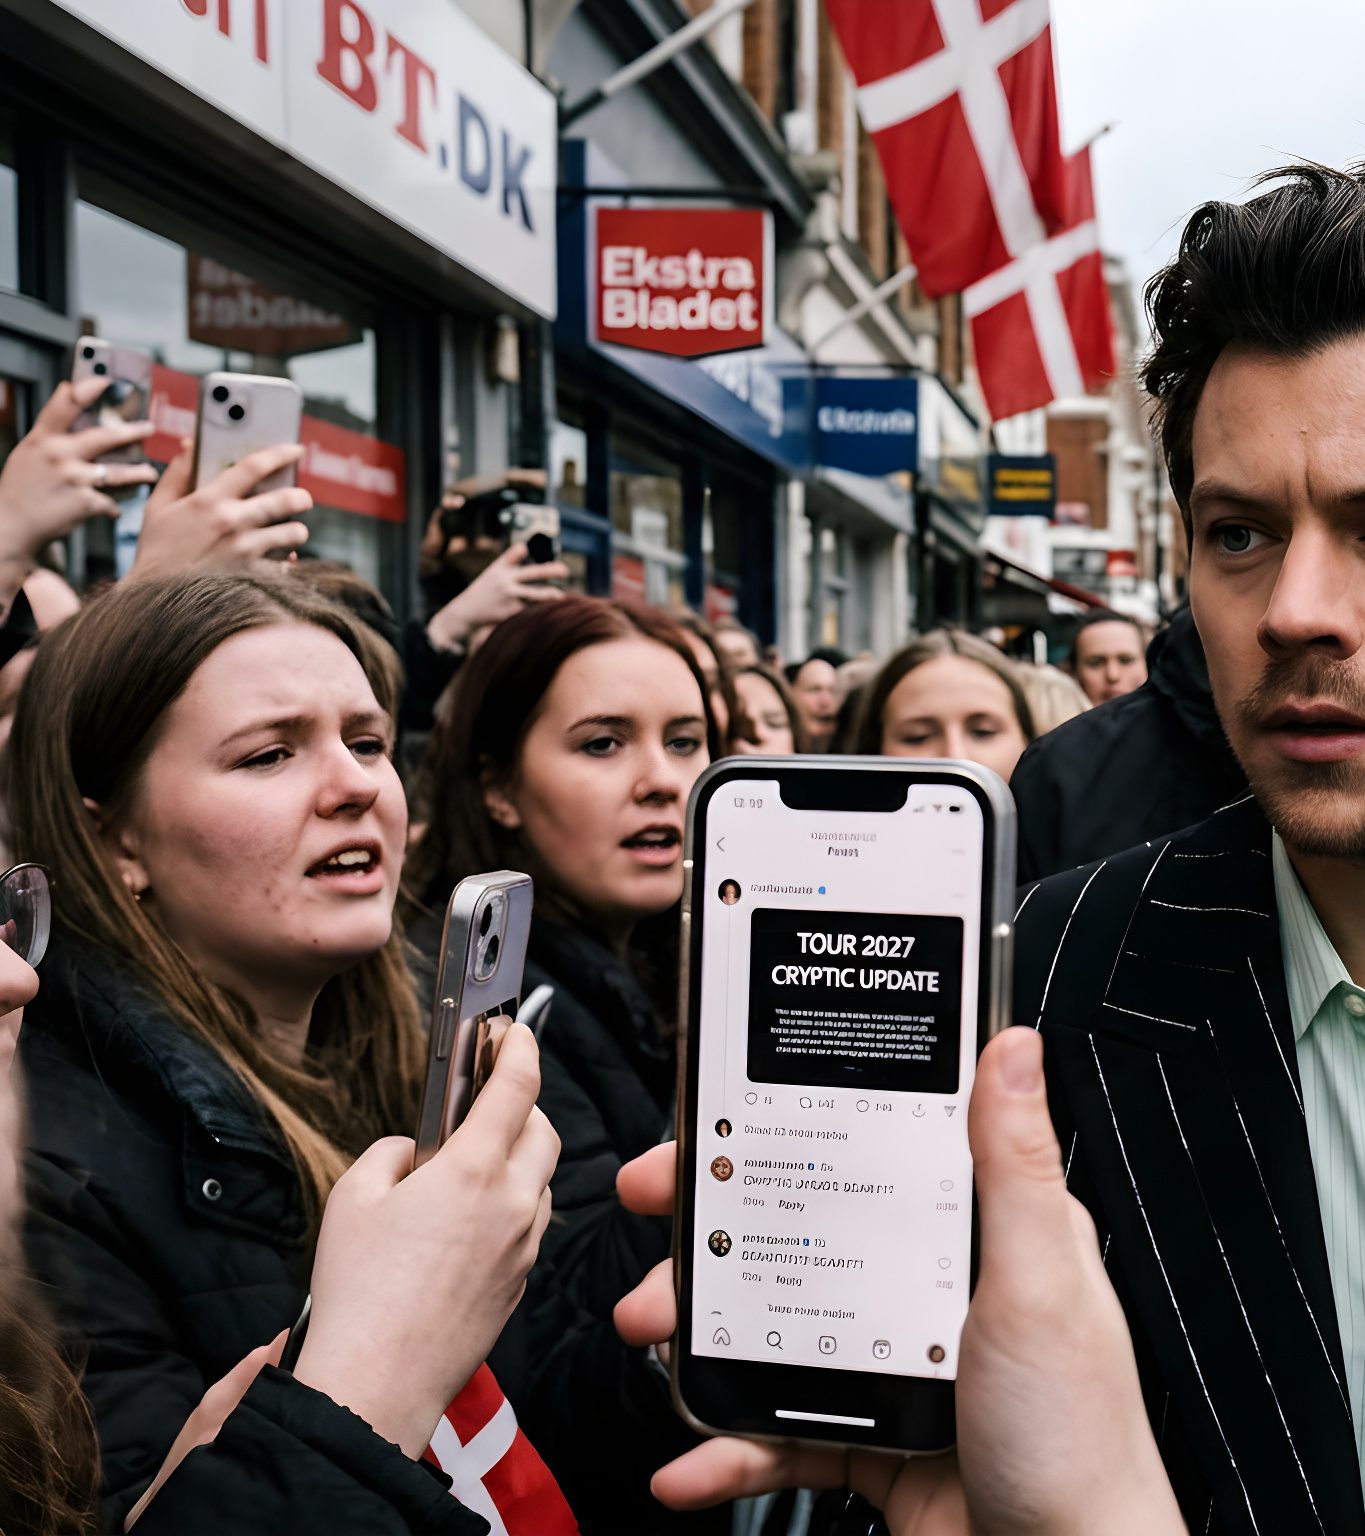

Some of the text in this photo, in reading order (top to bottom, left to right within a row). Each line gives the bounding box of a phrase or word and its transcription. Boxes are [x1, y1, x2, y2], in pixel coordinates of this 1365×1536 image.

[316, 0, 535, 234] BT.DK
[602, 246, 755, 290] Ekstra
[796, 932, 916, 959] TOUR 2027
[771, 964, 940, 993] CRYPTIC UPDATE
